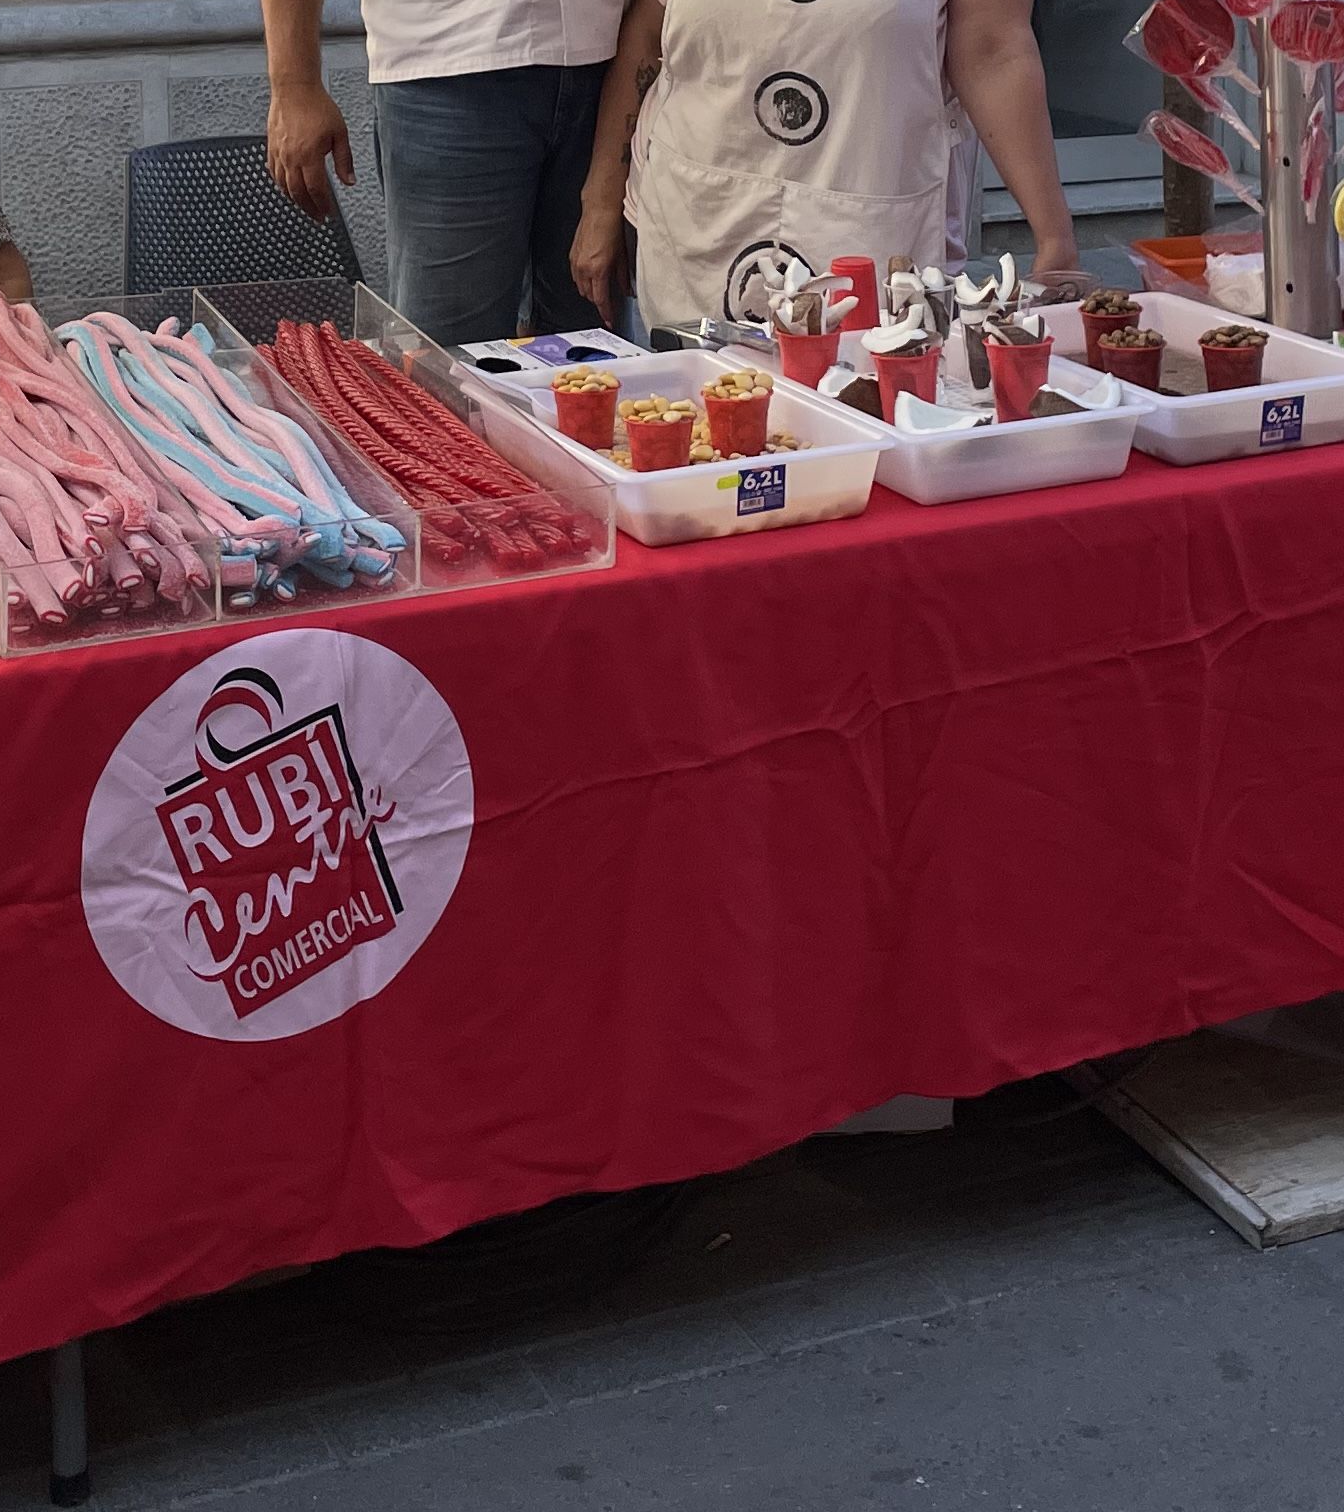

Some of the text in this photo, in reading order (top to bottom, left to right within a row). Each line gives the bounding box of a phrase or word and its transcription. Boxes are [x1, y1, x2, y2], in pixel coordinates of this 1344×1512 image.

[1266, 404, 1300, 424] 6,2L
[743, 470, 783, 491] 6,2L
[169, 724, 343, 875] RUBÍ
[184, 784, 398, 983] Centre
[233, 890, 384, 1000] COMERCIAL
